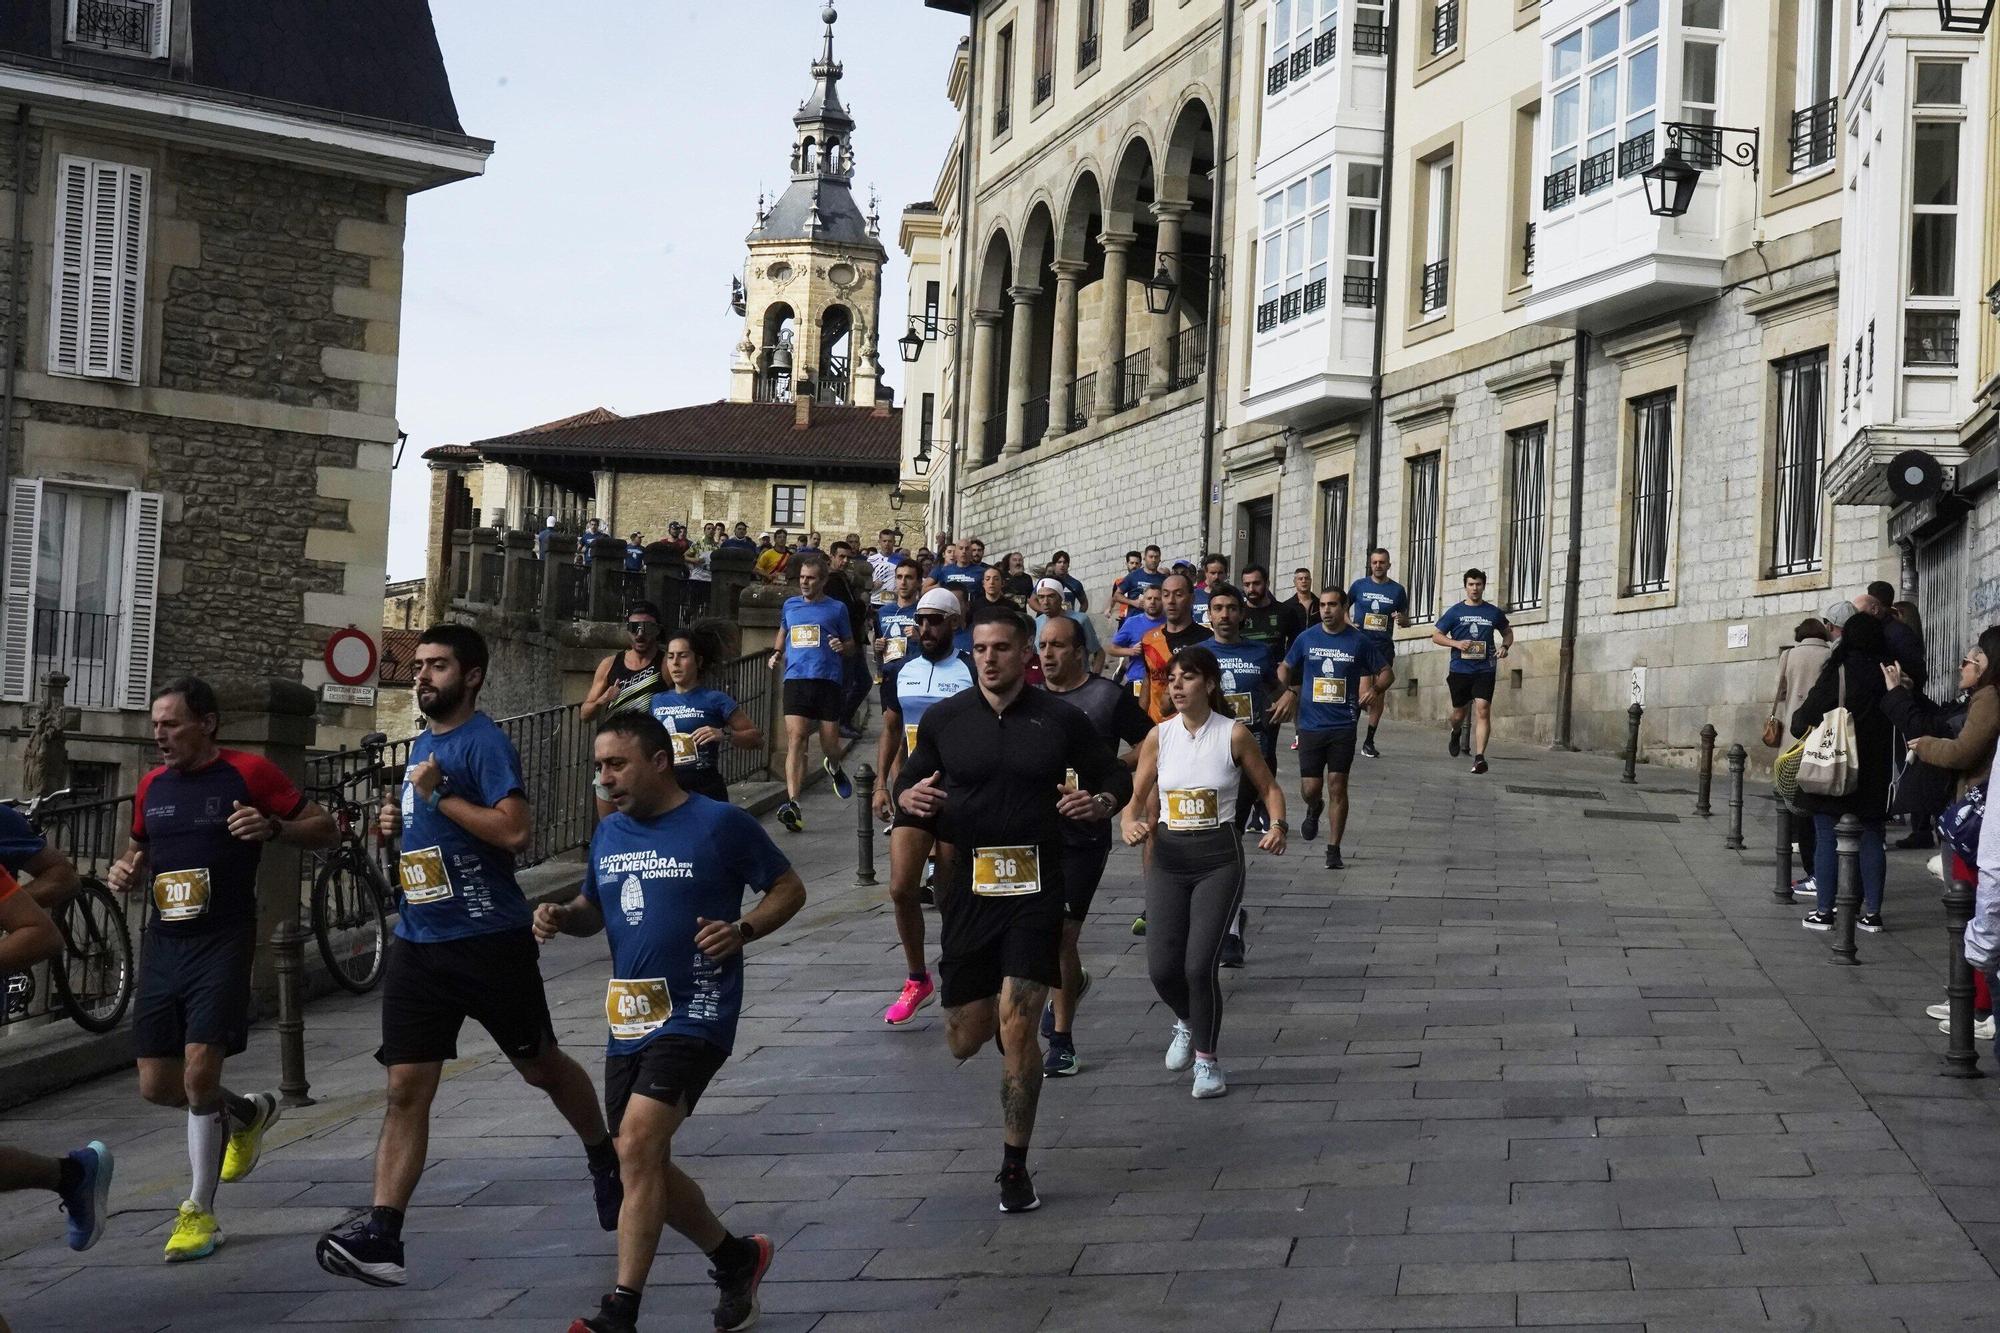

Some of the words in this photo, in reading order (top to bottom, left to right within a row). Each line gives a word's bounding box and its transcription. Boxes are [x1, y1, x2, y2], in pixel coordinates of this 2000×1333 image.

[1322, 684, 1338, 694] 180
[1178, 798, 1204, 815] 488
[600, 856, 608, 865] LA
[608, 850, 657, 863] CONQUISTA
[608, 857, 678, 874] ALMENDRA
[402, 864, 426, 884] 118
[642, 869, 693, 880] KONKISTA
[994, 858, 1017, 878] 36
[166, 882, 191, 902] 207
[618, 994, 652, 1017] 436
